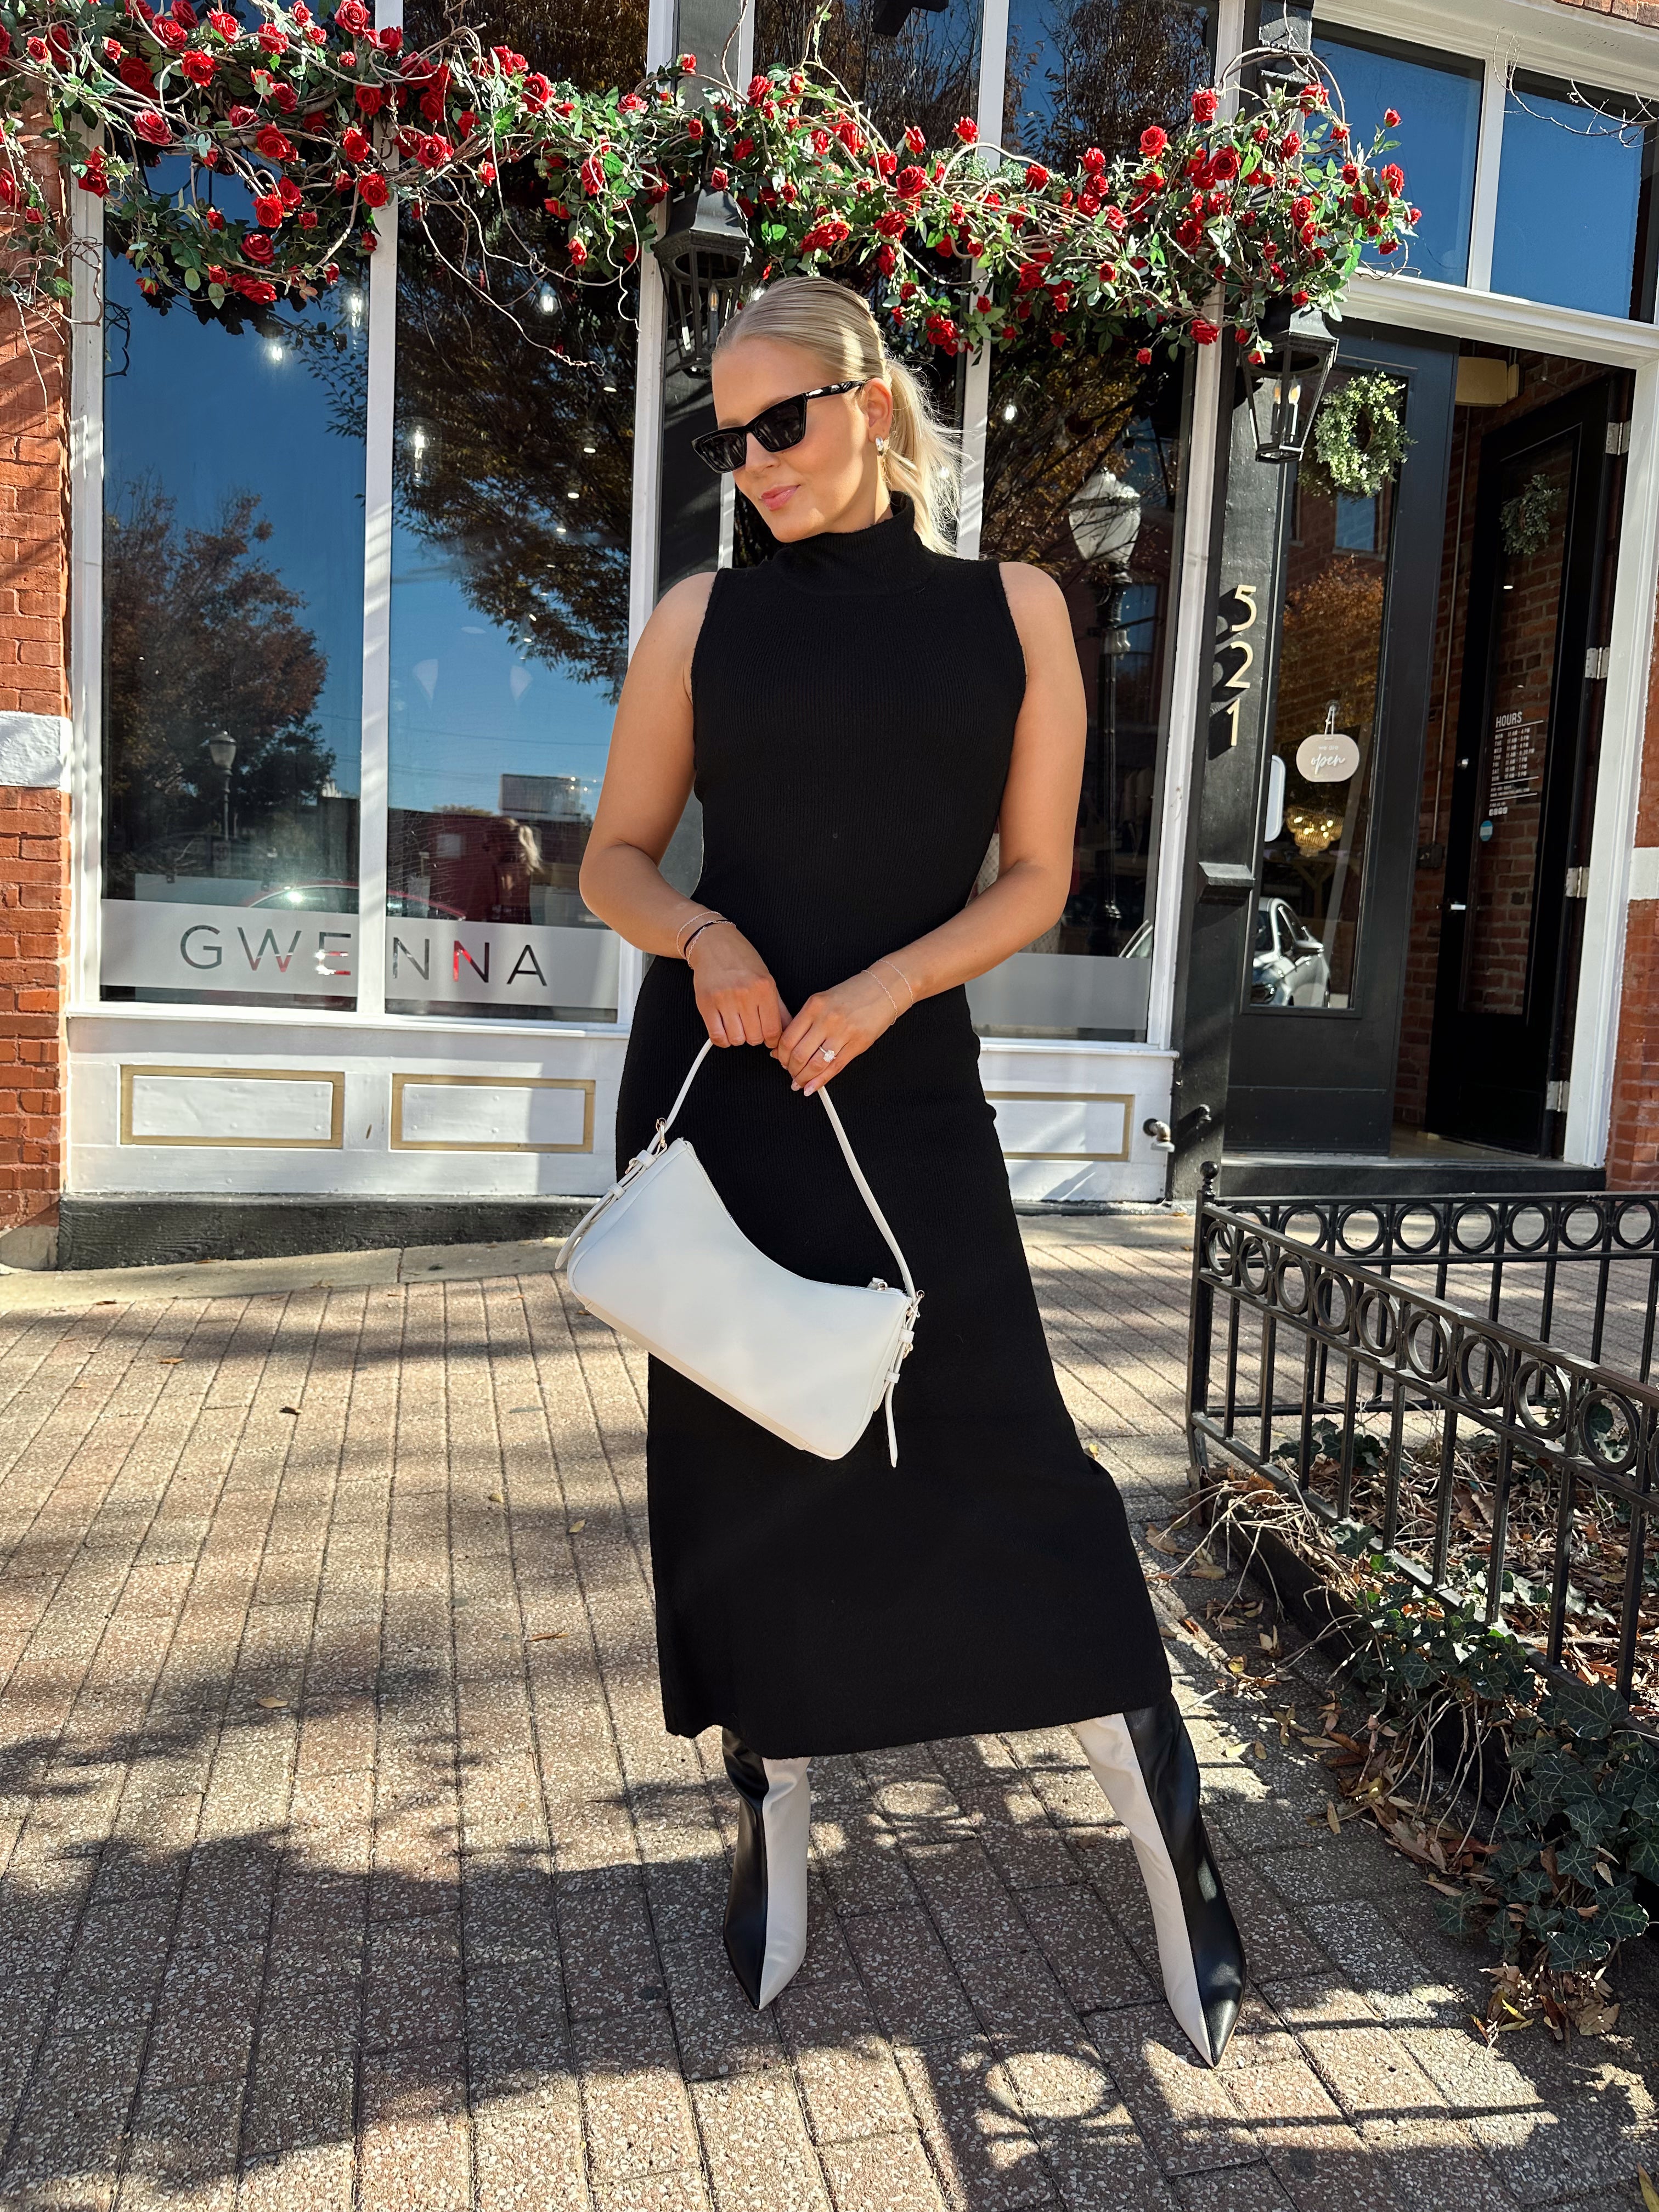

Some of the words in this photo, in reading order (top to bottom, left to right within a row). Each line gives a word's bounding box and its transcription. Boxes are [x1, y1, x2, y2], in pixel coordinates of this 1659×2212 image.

[1225, 584, 1257, 747] 521
[1496, 712, 1522, 728] HOURS
[1311, 753, 1346, 775] open
[180, 925, 547, 987] GWENNA
